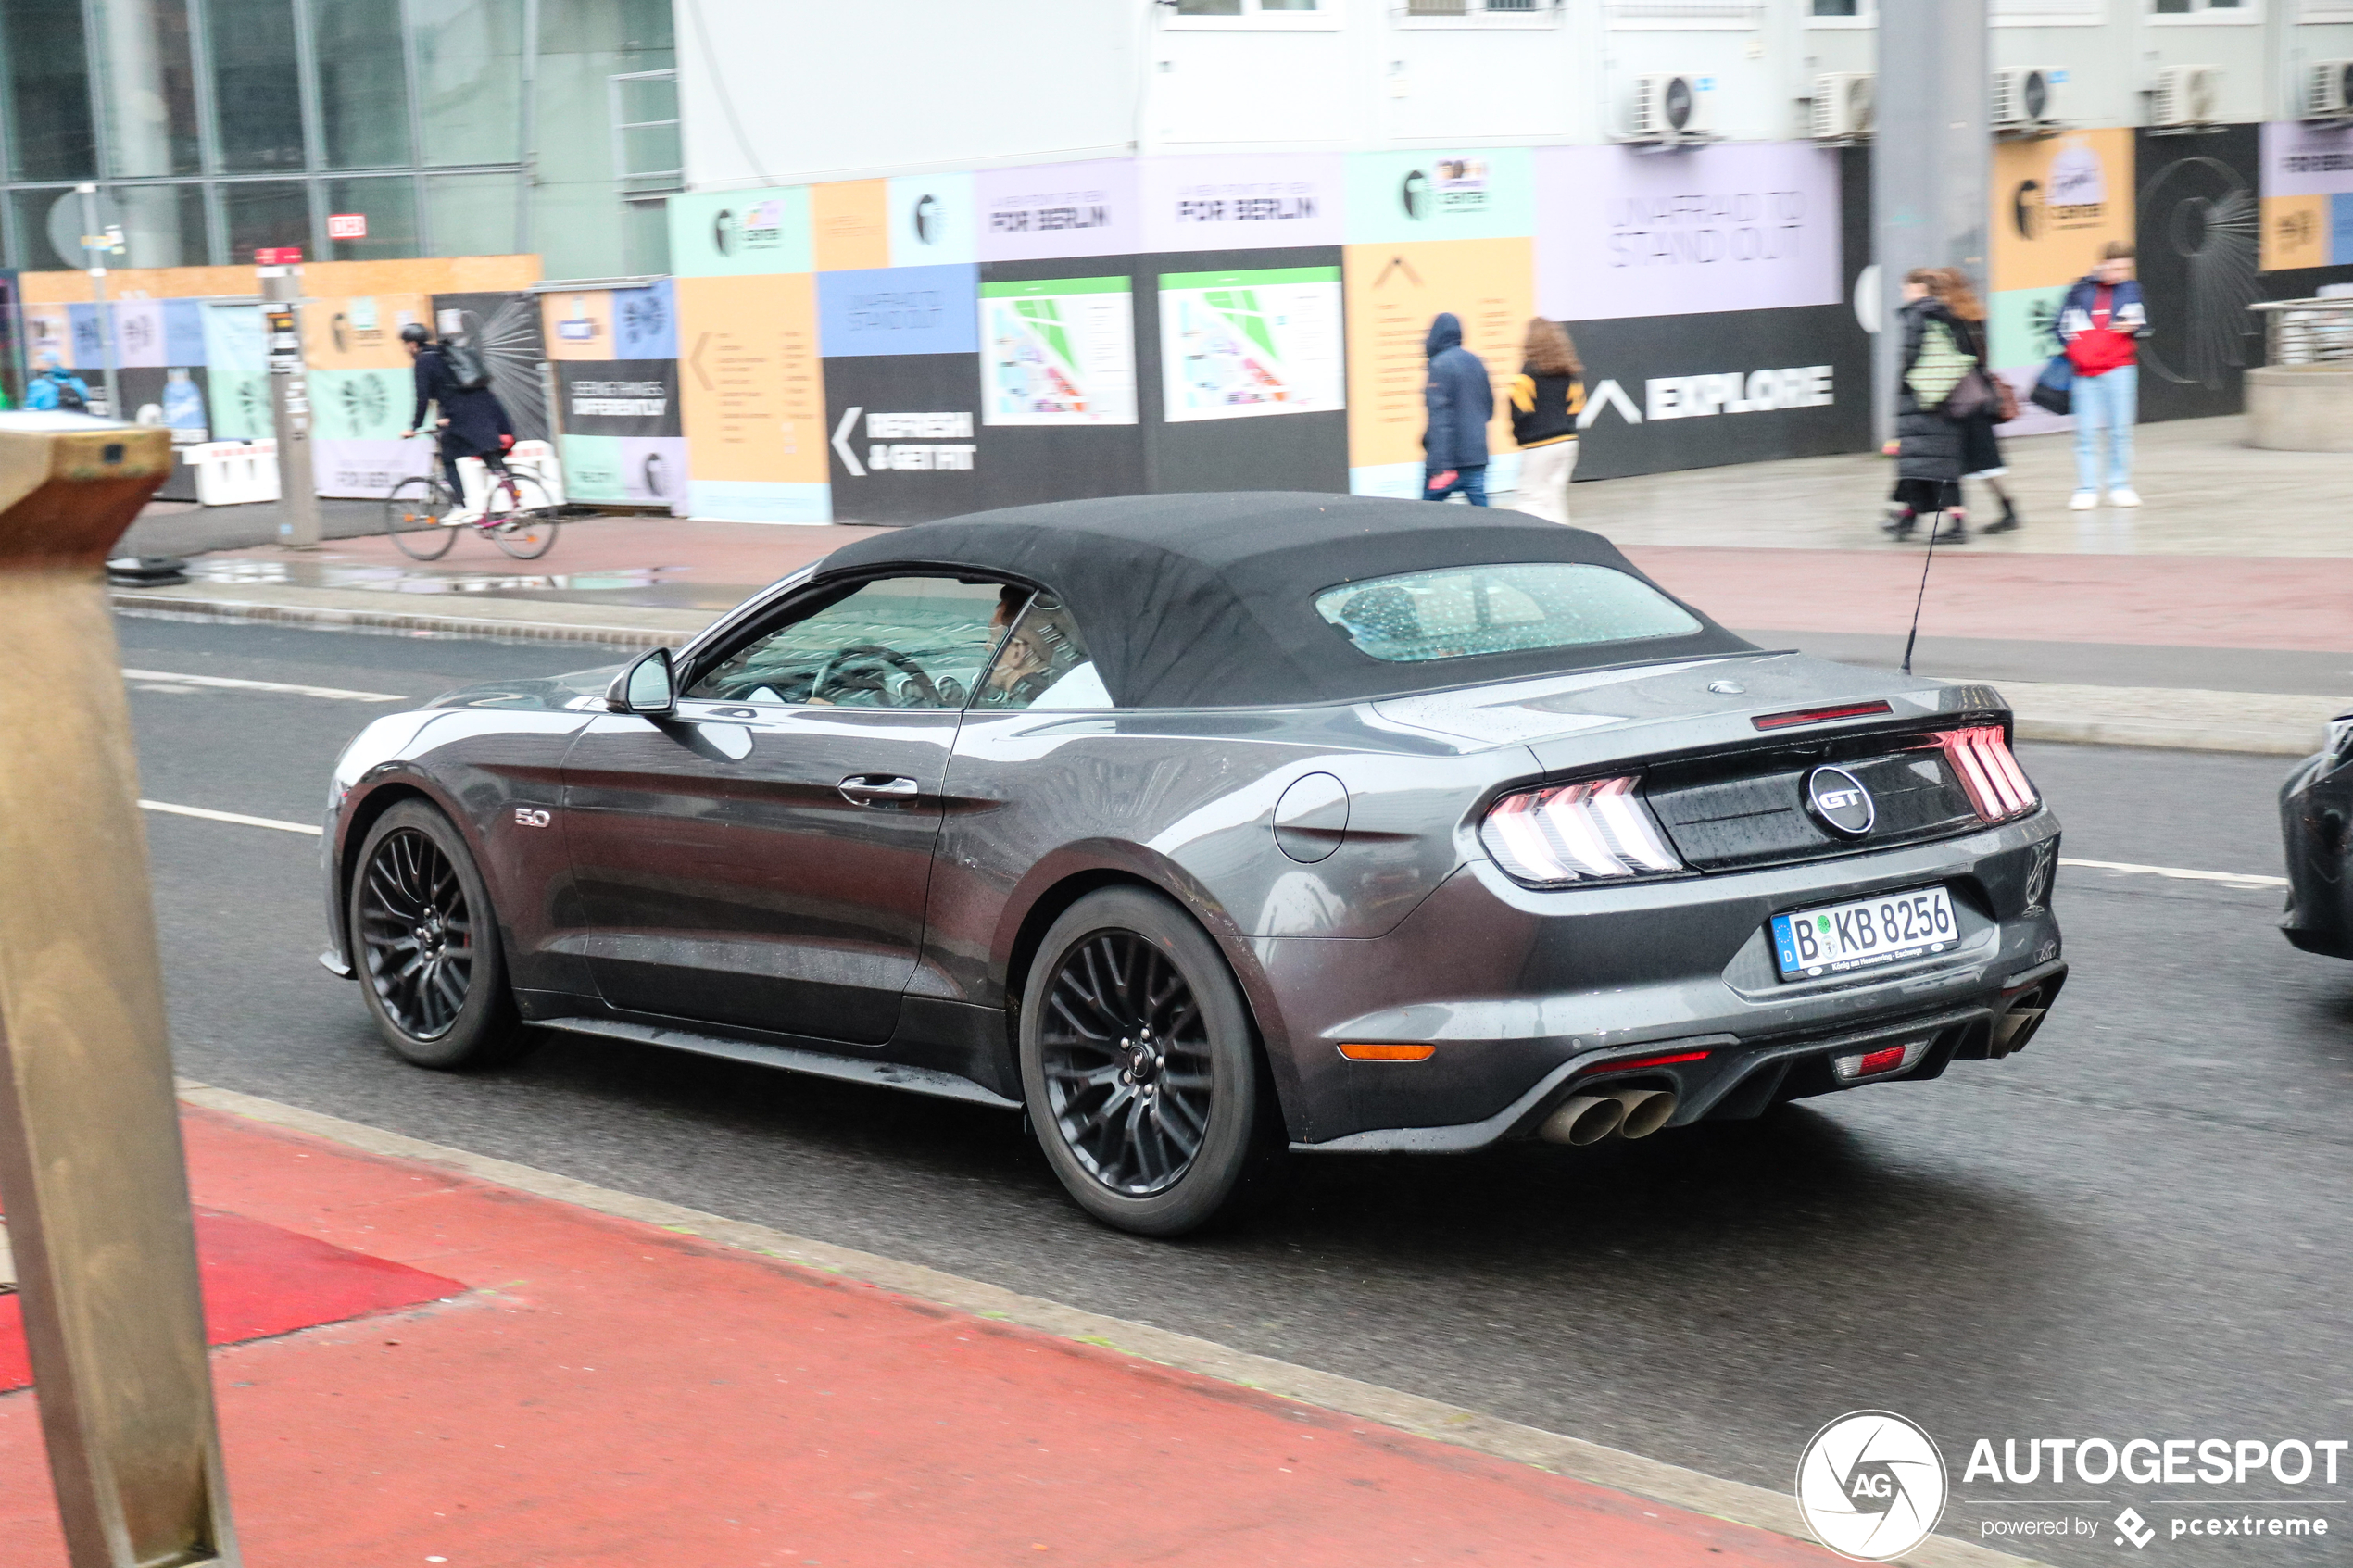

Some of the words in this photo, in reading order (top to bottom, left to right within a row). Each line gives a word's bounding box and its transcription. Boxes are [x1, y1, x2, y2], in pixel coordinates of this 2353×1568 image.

[989, 209, 1029, 233] FOR
[1037, 205, 1112, 232] BERLIN
[1176, 199, 1226, 222] FOR
[1234, 196, 1319, 221] BERLIN
[1645, 365, 1834, 420] EXPLORE
[1819, 789, 1860, 809] GT
[1794, 918, 1818, 961] B
[1834, 908, 1877, 954] KB
[1881, 894, 1950, 944] 8256
[1783, 949, 1793, 963] D
[1831, 961, 1850, 972] König
[1851, 959, 1860, 967] am
[1860, 953, 1893, 966] Hessenring
